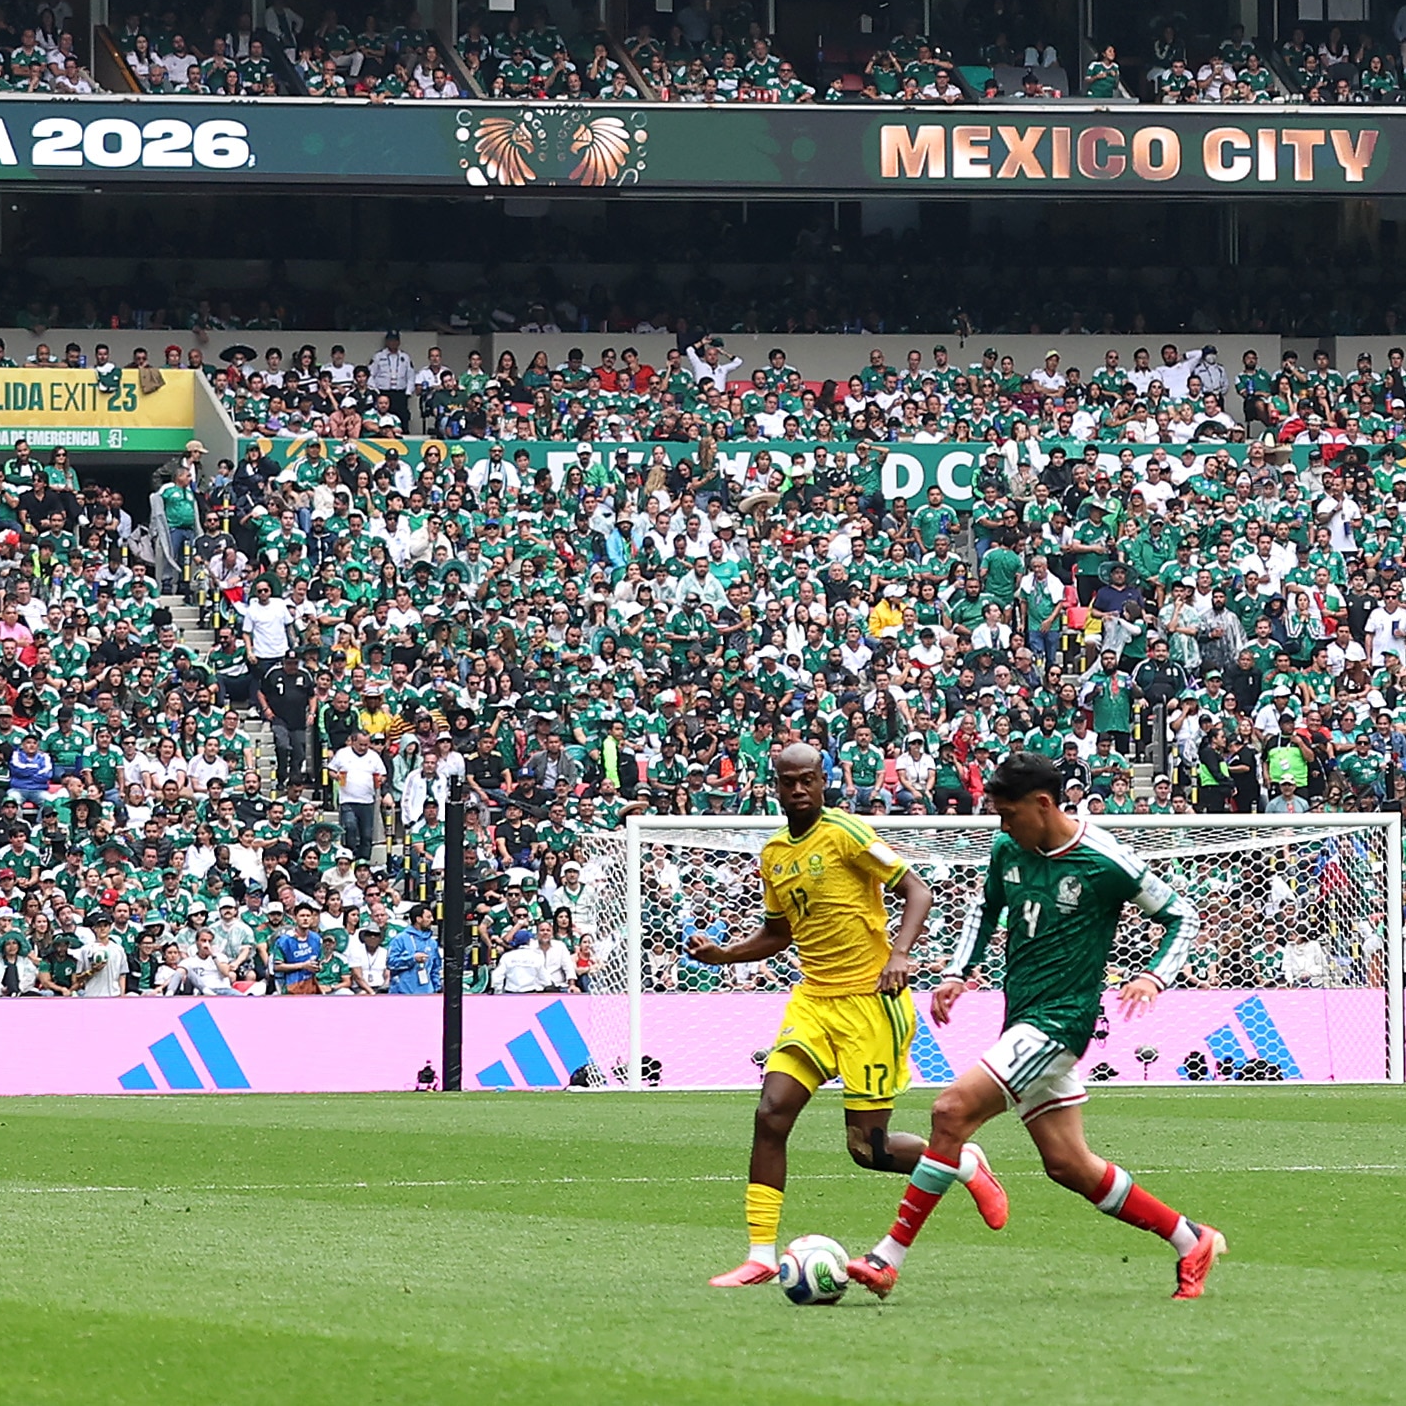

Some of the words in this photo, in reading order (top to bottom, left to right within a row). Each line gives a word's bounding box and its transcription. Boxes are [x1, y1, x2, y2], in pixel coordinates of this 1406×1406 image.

[31, 118, 249, 169] 2026
[880, 124, 1181, 182] MEXICO
[1202, 126, 1380, 182] CITY
[50, 382, 98, 411] EXIT
[107, 382, 138, 412] 23
[11, 430, 27, 445] DE
[27, 430, 101, 447] EMERGENCIA
[1023, 899, 1041, 938] 4
[1008, 1038, 1032, 1069] 4
[864, 1063, 889, 1096] 17
